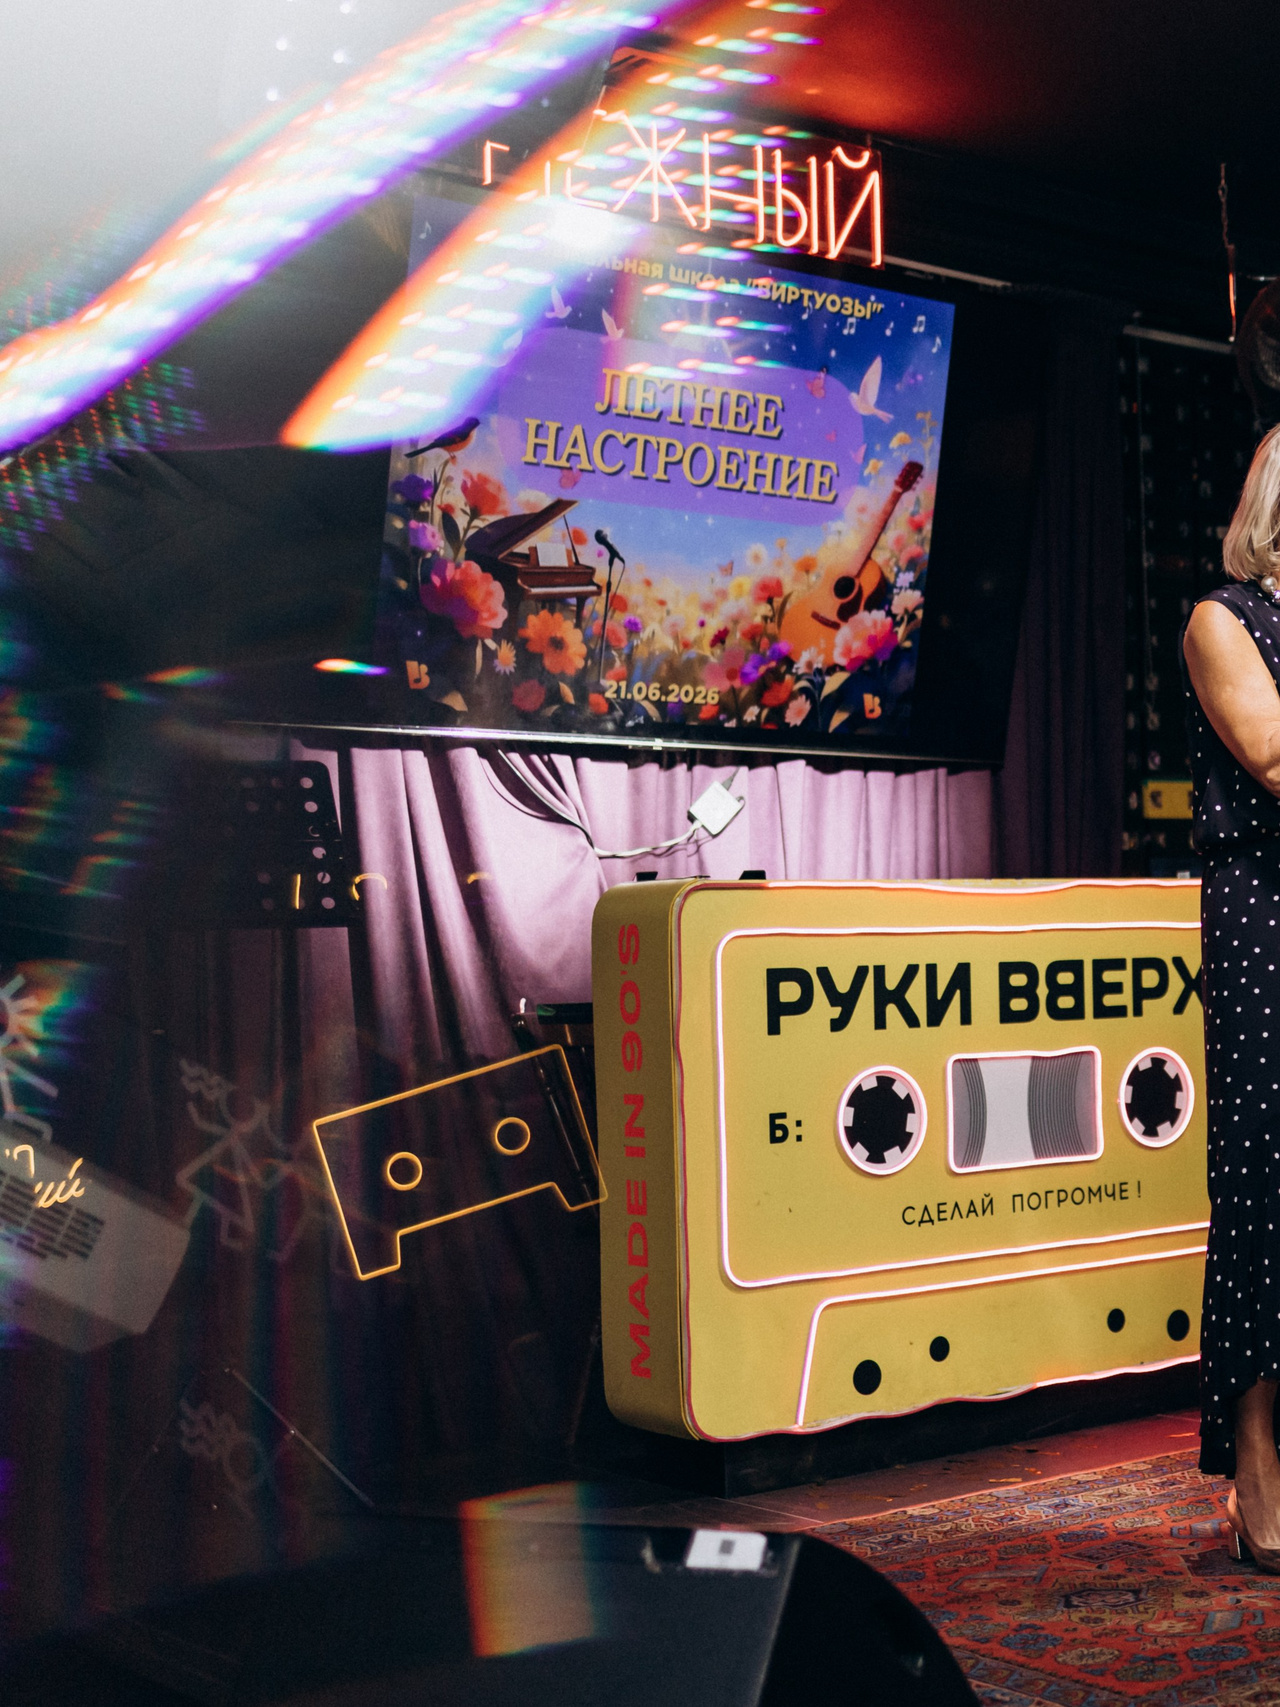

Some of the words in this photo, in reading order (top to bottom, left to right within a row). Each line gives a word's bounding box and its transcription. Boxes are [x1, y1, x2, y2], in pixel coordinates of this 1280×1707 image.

[595, 367, 784, 438] ЛЕТНЕЕ
[521, 417, 839, 503] НАСТРОЕНИЕ
[604, 680, 720, 705] 21.06.2026
[618, 923, 643, 1073] 90'S
[765, 961, 973, 1036] РУКИ
[623, 1093, 647, 1159] IN
[768, 1112, 803, 1144] Б:
[901, 1193, 995, 1228] СДЕЛАЙ
[626, 1179, 652, 1379] MADE
